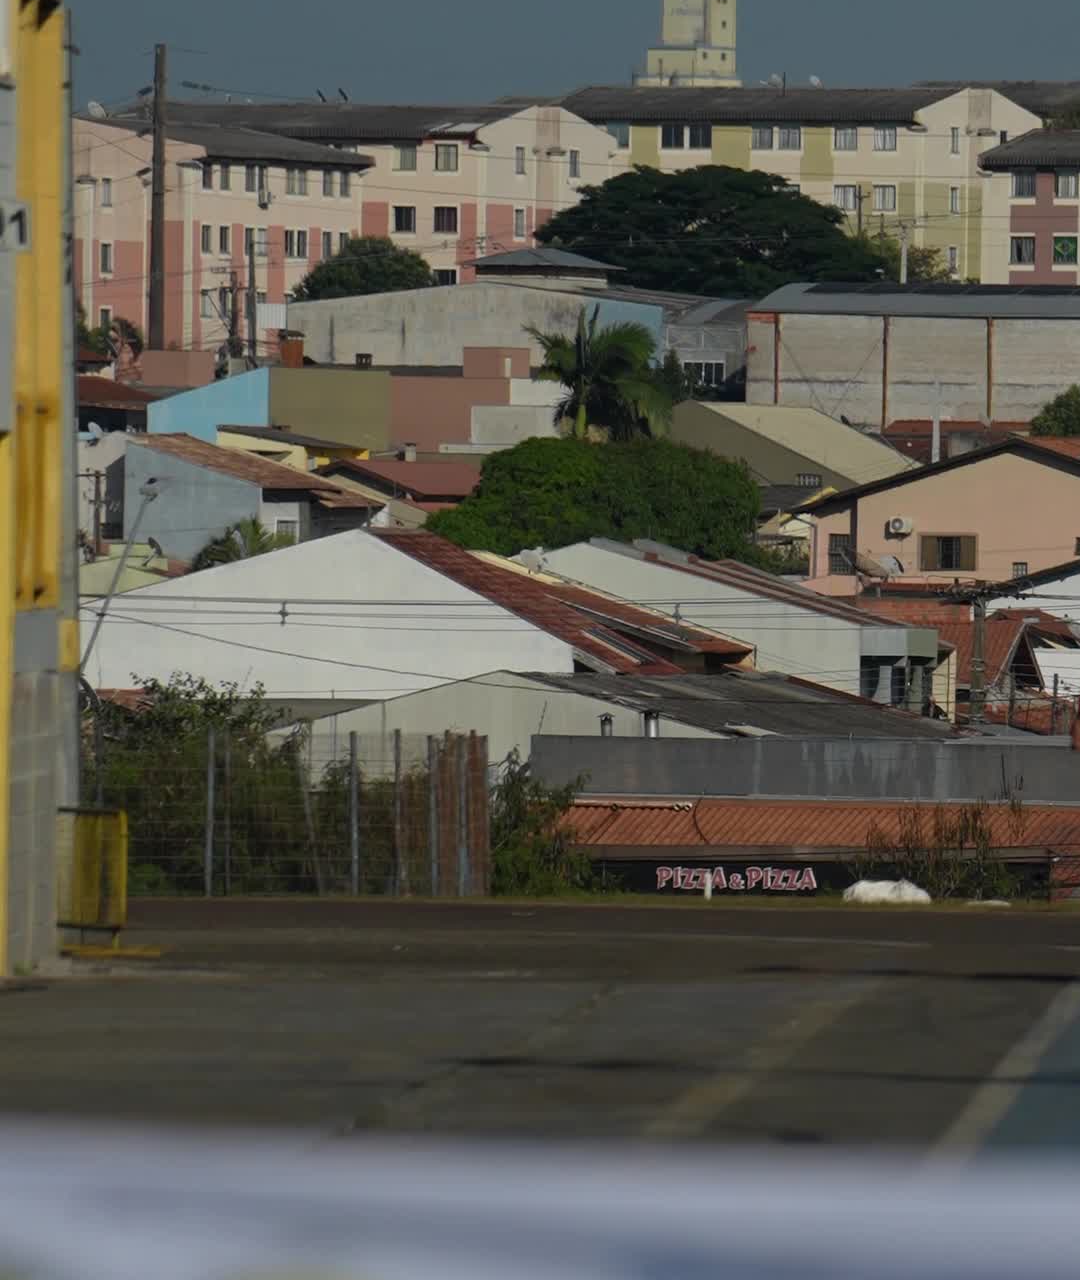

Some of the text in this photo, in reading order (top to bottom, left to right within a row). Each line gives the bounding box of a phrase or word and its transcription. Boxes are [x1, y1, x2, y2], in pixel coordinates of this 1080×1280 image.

[0, 208, 26, 245] 1
[656, 866, 817, 891] PIZZA & PIZZA
